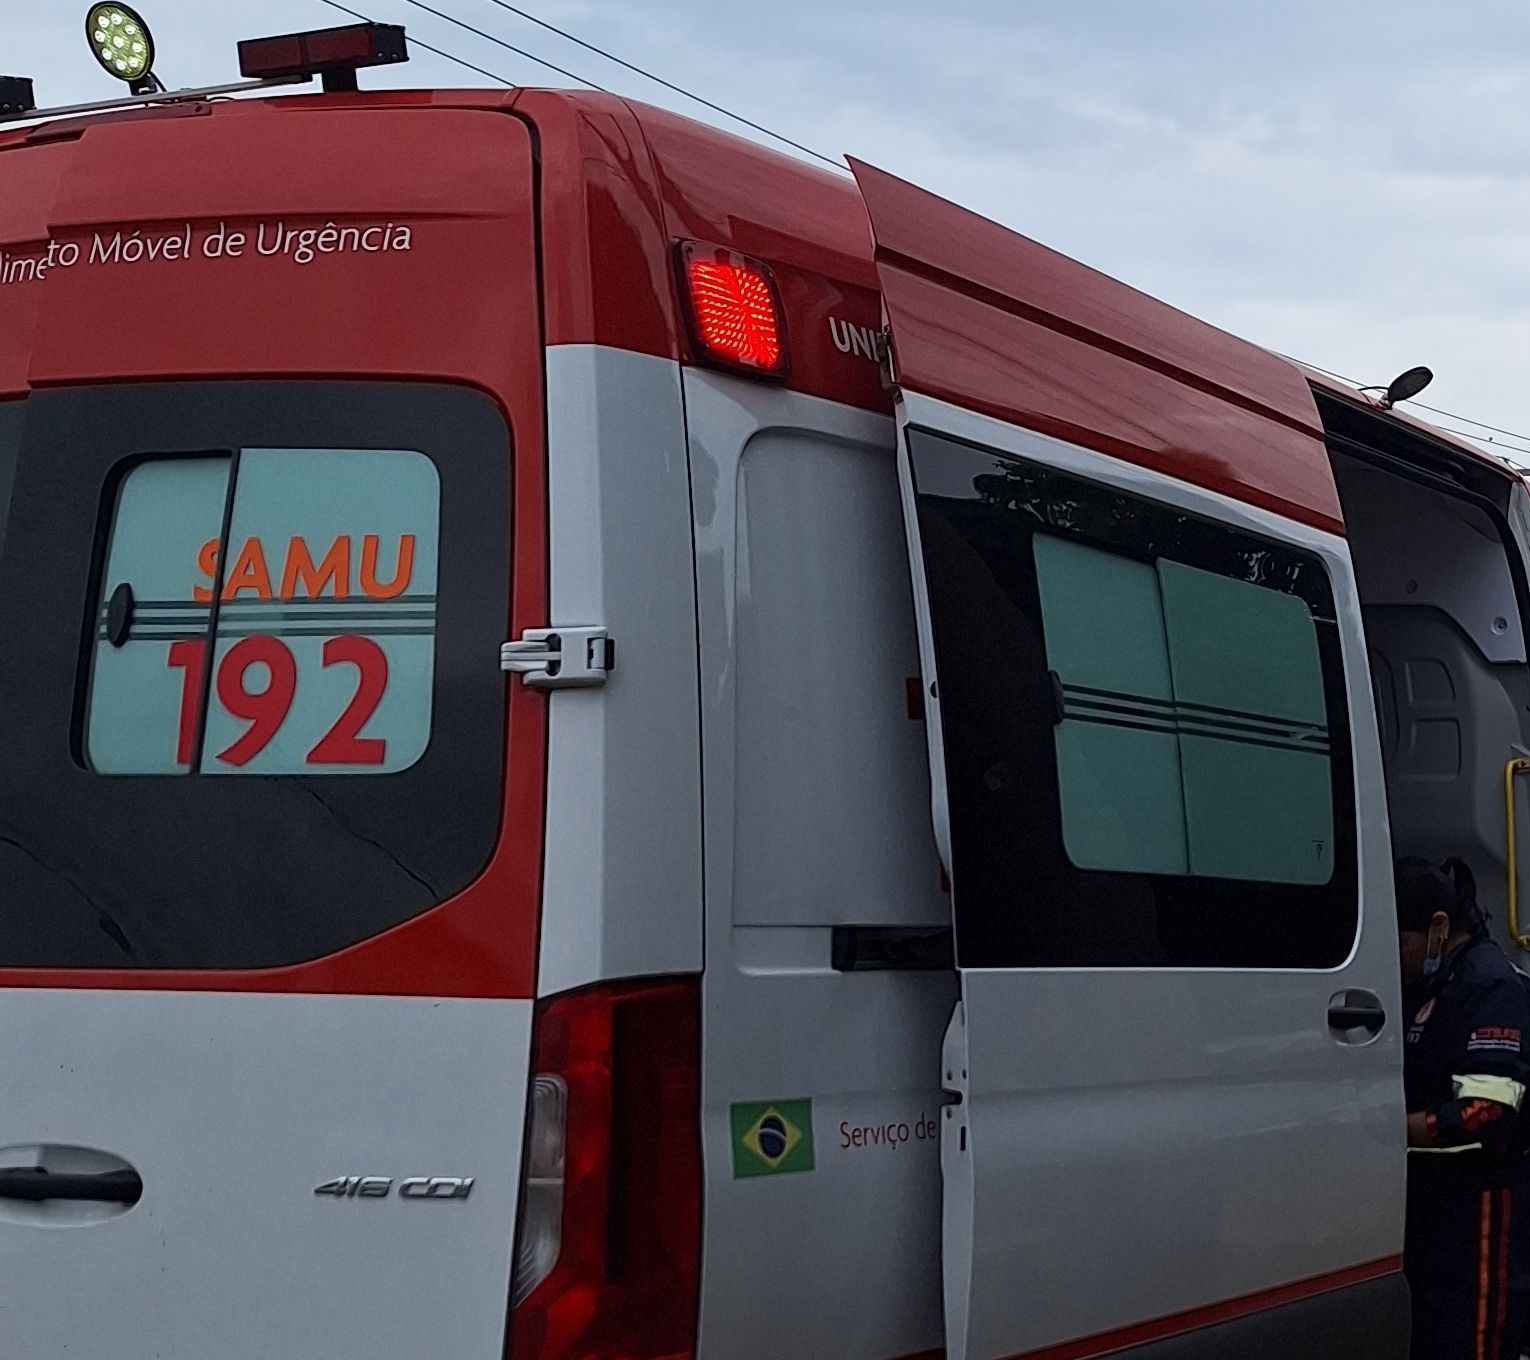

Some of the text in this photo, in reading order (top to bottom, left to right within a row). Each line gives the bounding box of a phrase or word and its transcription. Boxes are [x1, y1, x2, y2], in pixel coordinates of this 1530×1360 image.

[89, 223, 191, 264] Móvel
[202, 221, 246, 257] de
[257, 221, 411, 264] Urgência
[828, 316, 882, 363] UNI
[193, 534, 416, 604] SAMU
[167, 634, 389, 767] 192
[840, 1112, 936, 1150] Serviço de
[314, 1176, 475, 1200] 416 CDI
